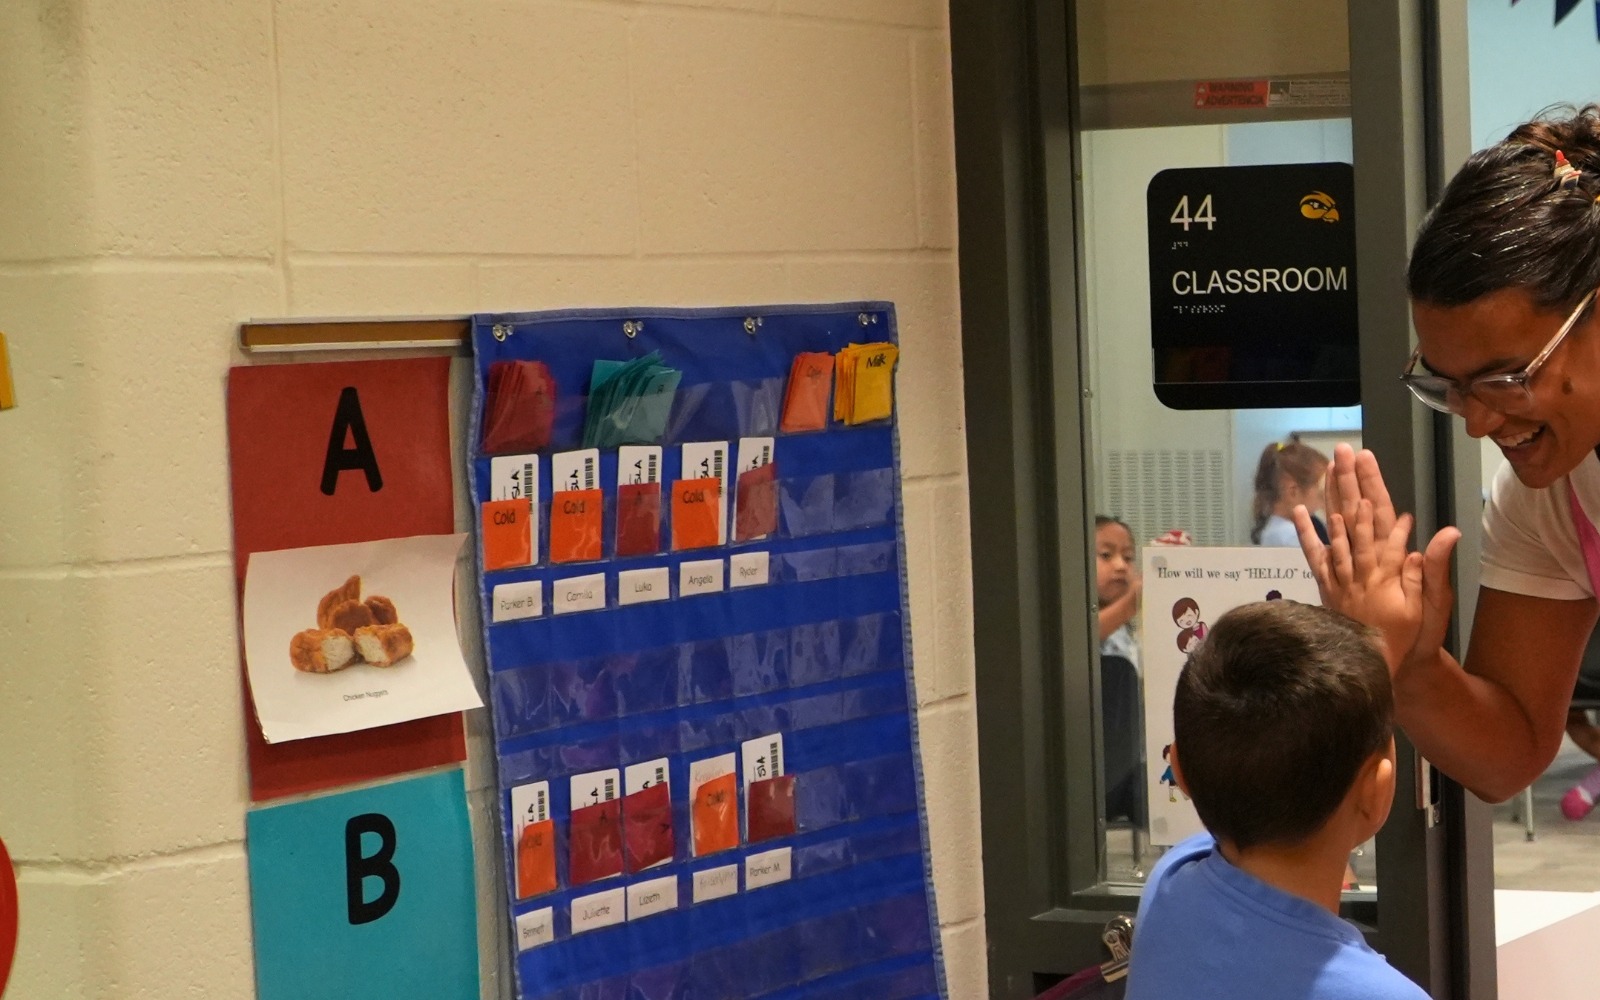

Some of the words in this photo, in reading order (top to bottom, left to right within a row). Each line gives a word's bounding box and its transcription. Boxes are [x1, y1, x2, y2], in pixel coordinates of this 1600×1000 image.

[1170, 194, 1217, 231] 44
[1172, 266, 1348, 295] CLASSROOM
[866, 353, 887, 368] Milk
[320, 386, 384, 497] A
[682, 489, 705, 504] Cold
[563, 499, 586, 515] Cold
[493, 508, 516, 526] Cold
[1157, 567, 1181, 579] How
[1184, 567, 1203, 579] will
[1207, 570, 1221, 578] we
[1224, 570, 1240, 582] say
[345, 813, 401, 926] B
